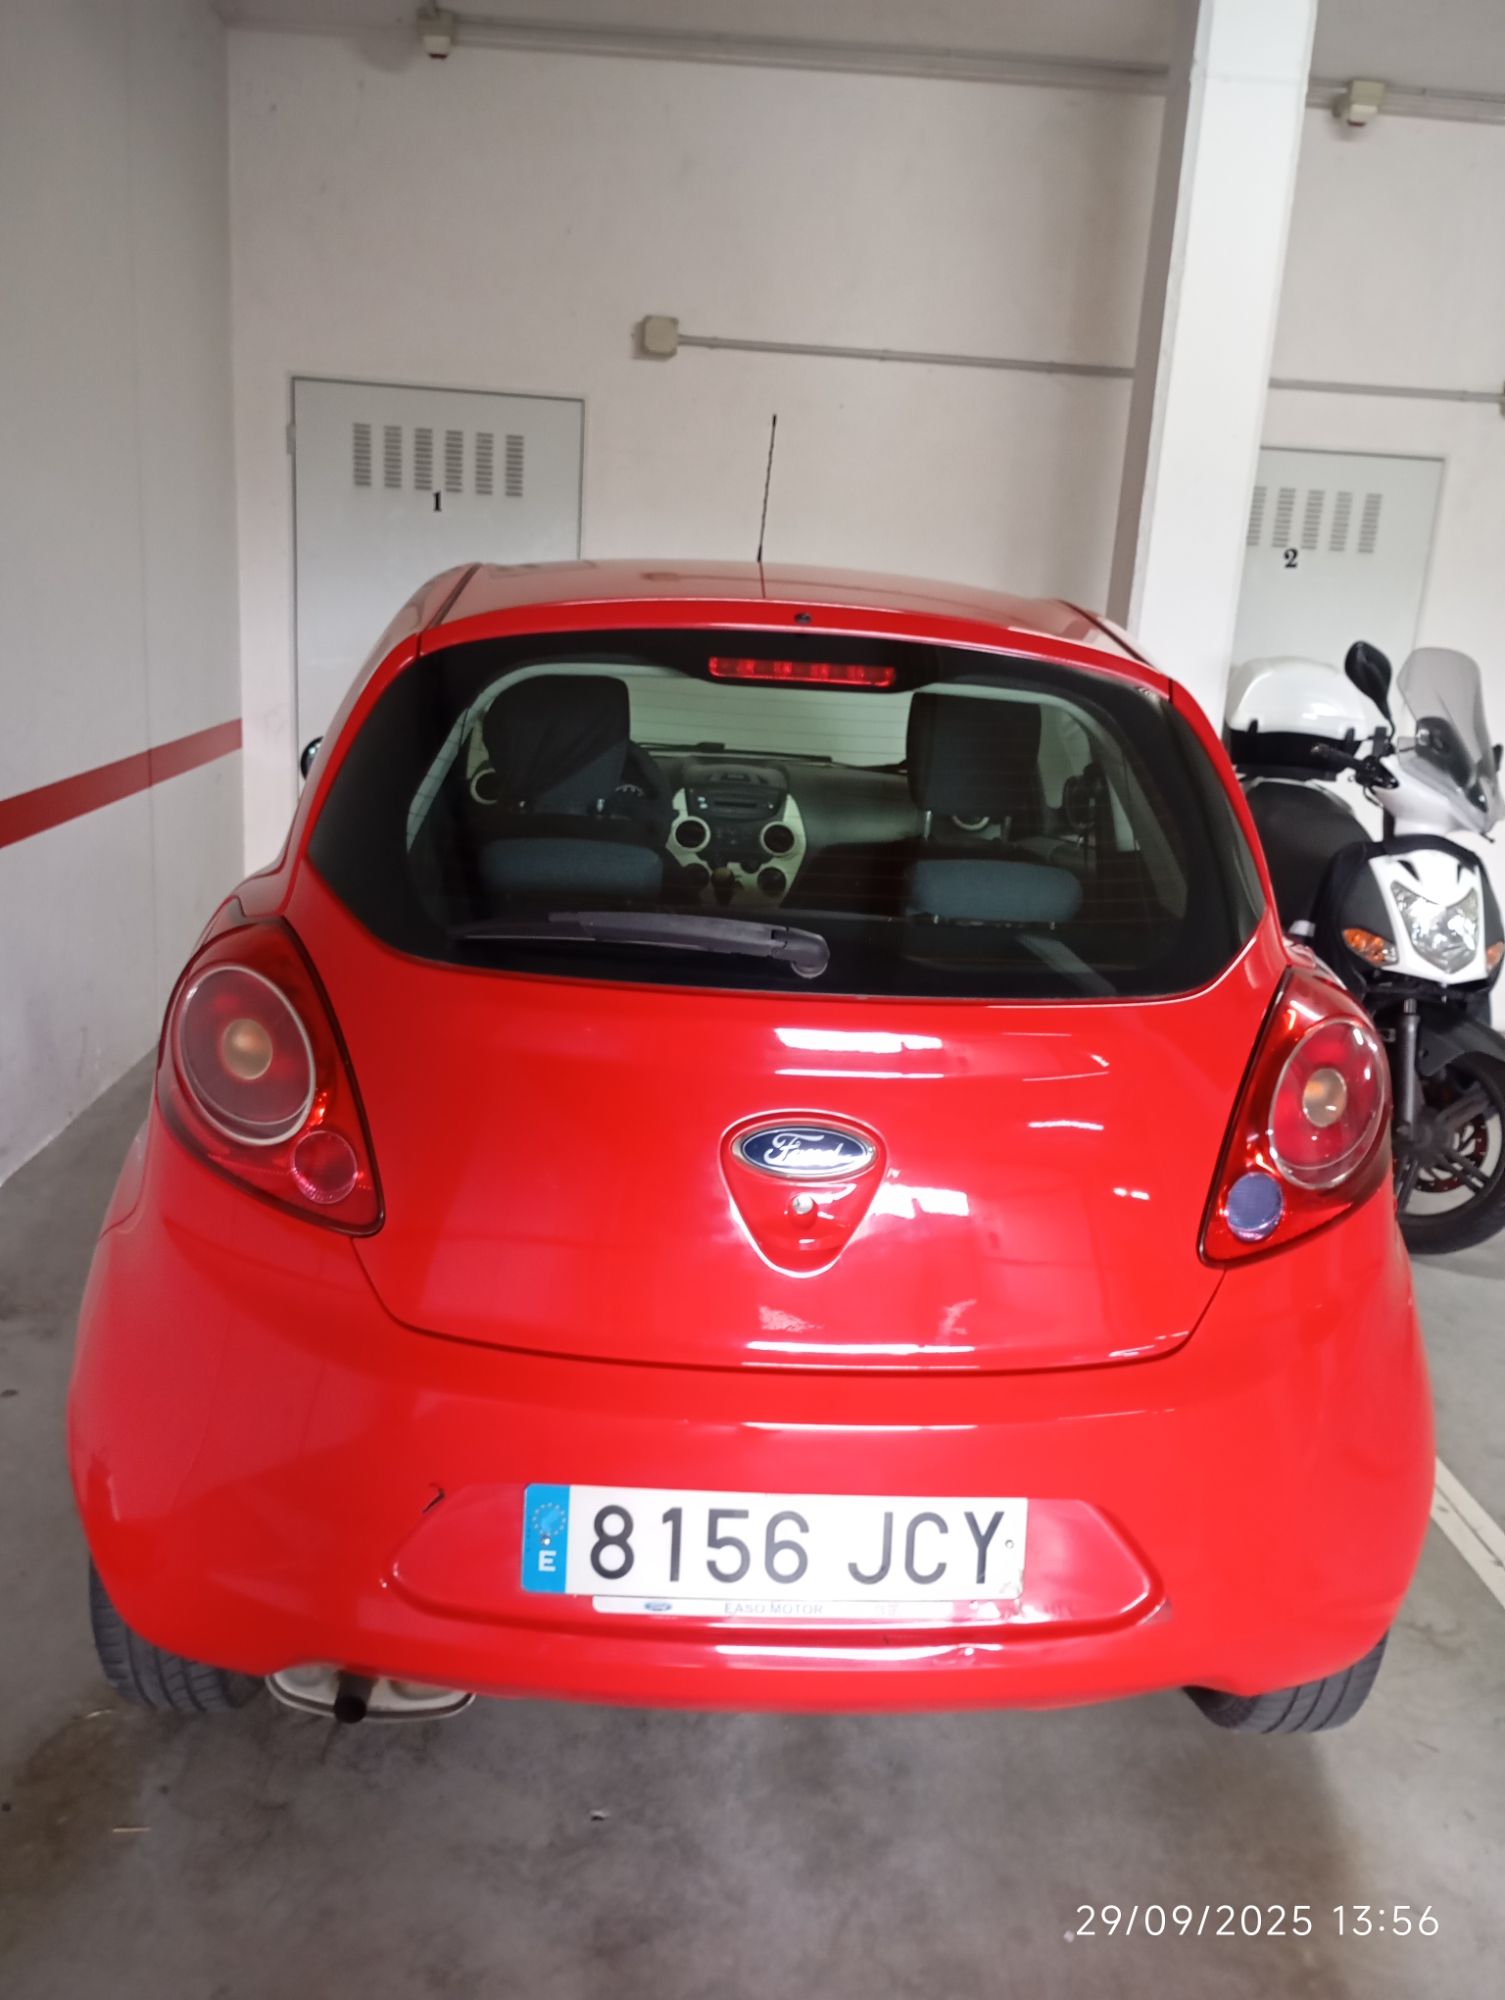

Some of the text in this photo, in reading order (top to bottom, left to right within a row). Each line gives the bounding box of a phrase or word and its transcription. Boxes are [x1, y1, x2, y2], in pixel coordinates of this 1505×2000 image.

[433, 491, 442, 512] 1
[1283, 548, 1299, 568] 2
[590, 1504, 1005, 1585] 8156 JCY
[538, 1550, 557, 1572] E
[770, 1603, 823, 1615] MOTOR
